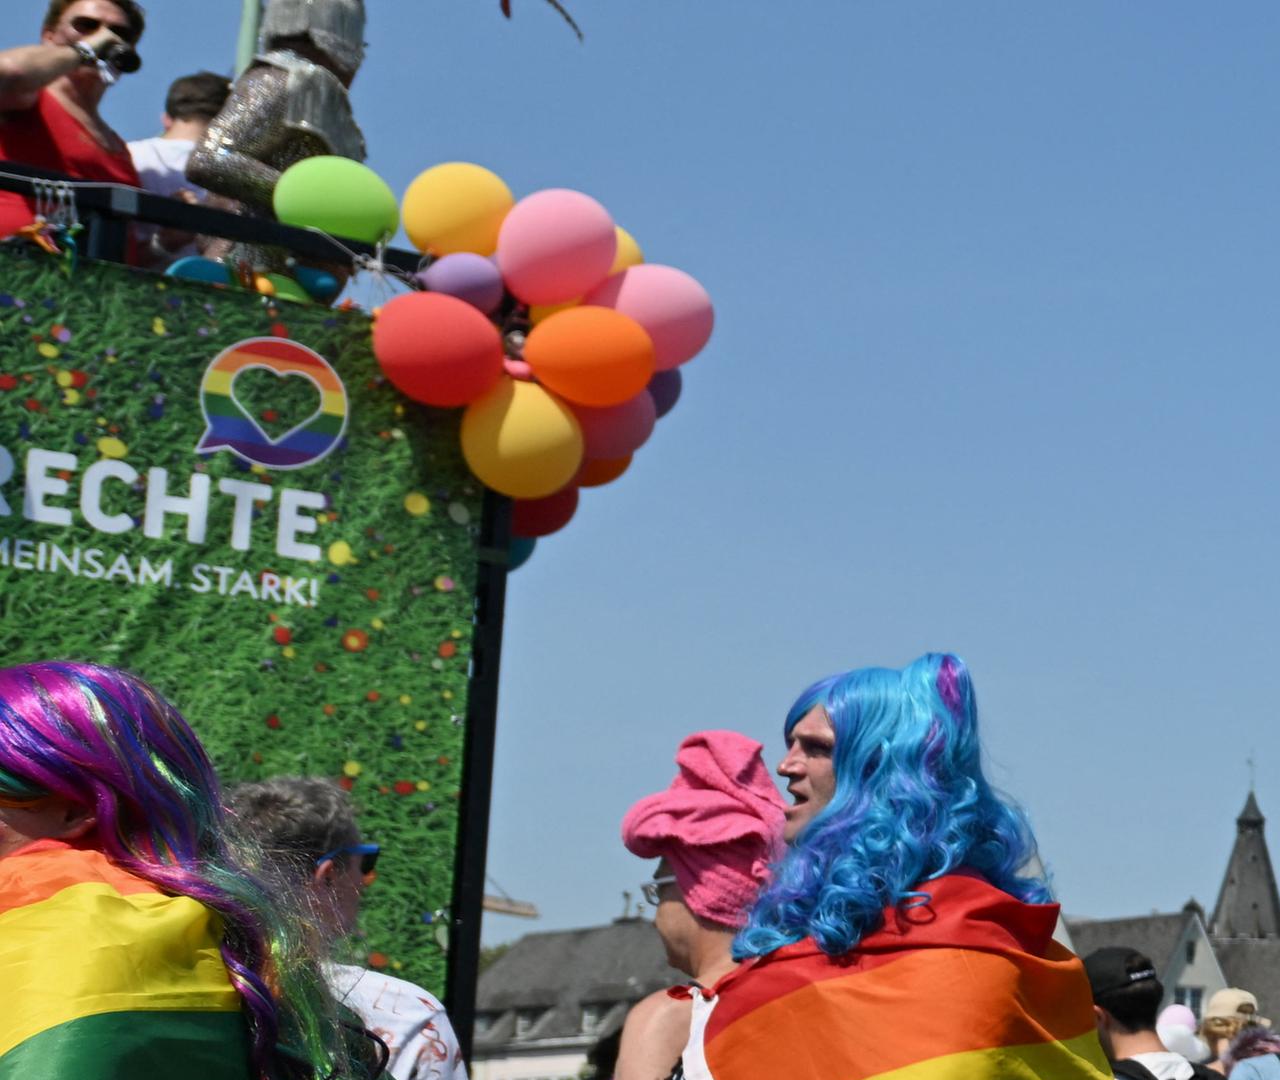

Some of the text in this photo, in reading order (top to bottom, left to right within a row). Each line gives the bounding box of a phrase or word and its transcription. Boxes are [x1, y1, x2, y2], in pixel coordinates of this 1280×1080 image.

[0, 444, 325, 562] ECHTE
[0, 536, 318, 607] EINSAM. STARK!
